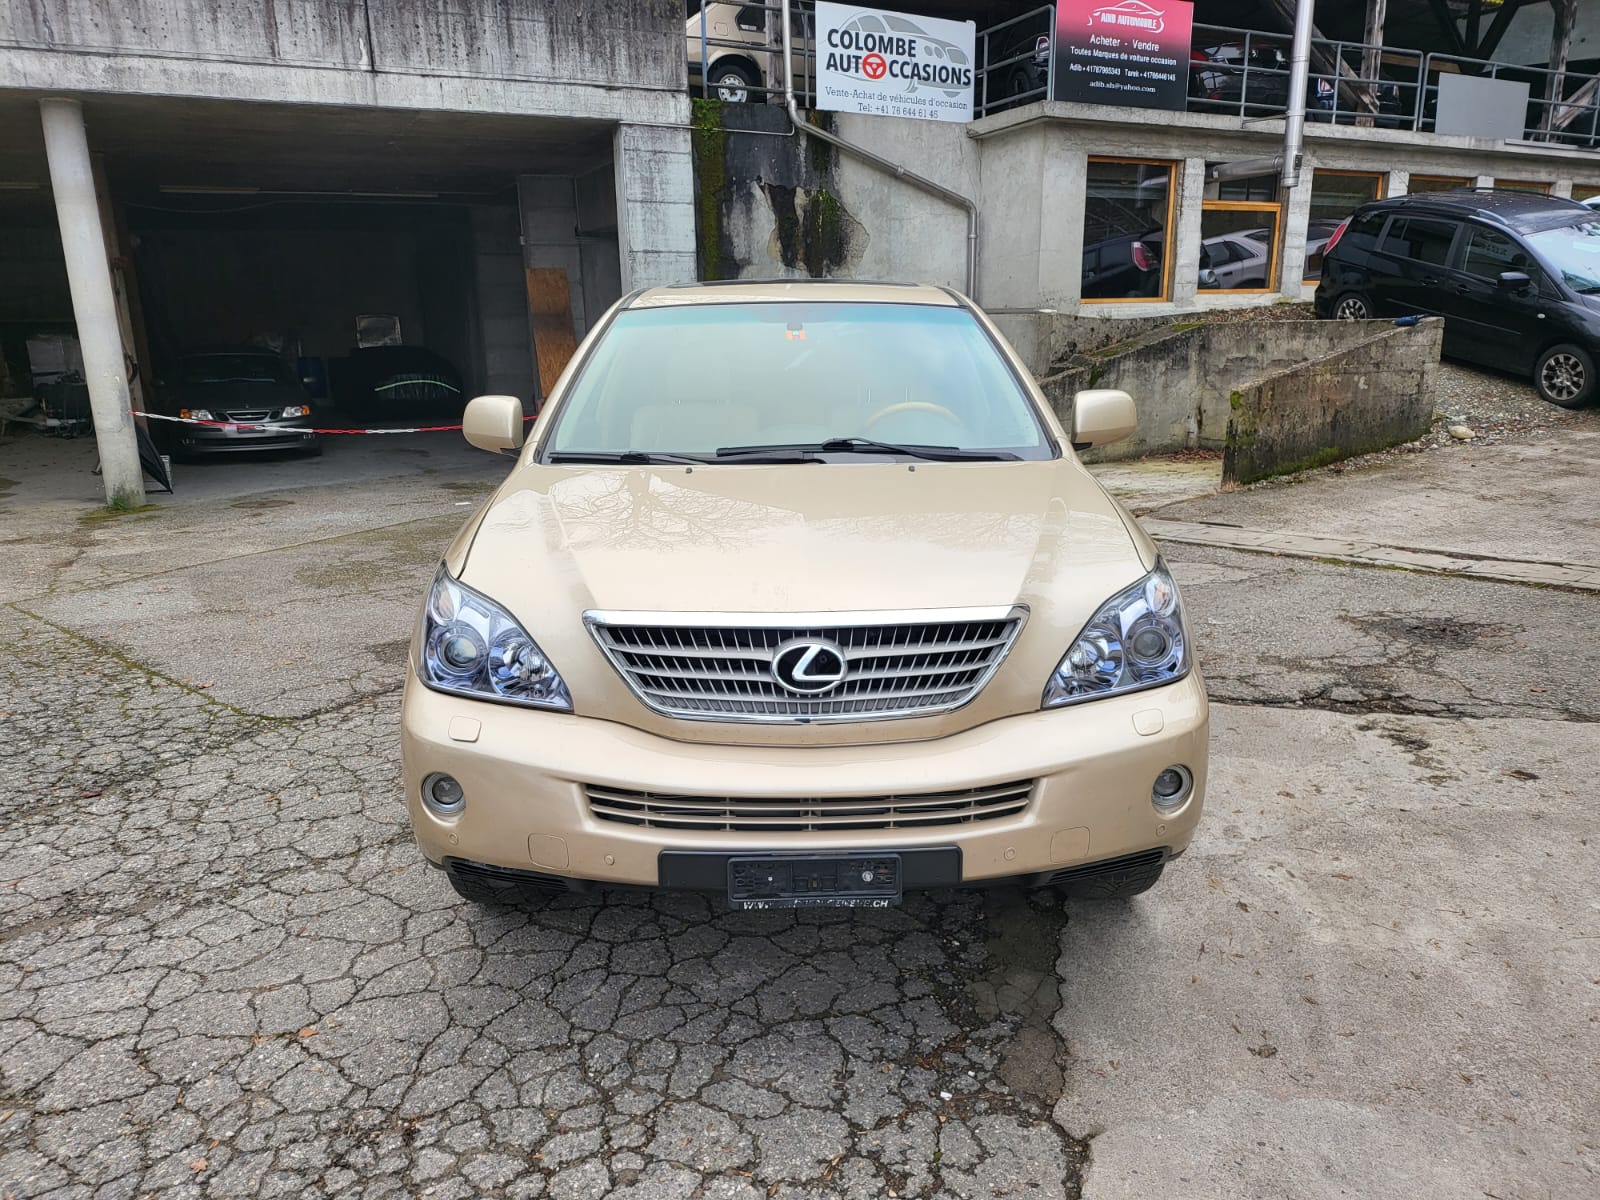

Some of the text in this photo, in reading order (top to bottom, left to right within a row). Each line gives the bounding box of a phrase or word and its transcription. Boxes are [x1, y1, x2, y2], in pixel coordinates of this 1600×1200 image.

[827, 28, 917, 58] COLOMBE
[1089, 33, 1121, 47] Acheter
[1132, 39, 1160, 52] Vendre
[1070, 46, 1177, 66] Toutes Marques de voiture occasion
[825, 86, 968, 110] Vente-Achat de véhicules d'occasion
[858, 102, 873, 112] Tel:
[874, 105, 889, 114] +41
[902, 107, 916, 117] 644
[929, 109, 939, 119] 45
